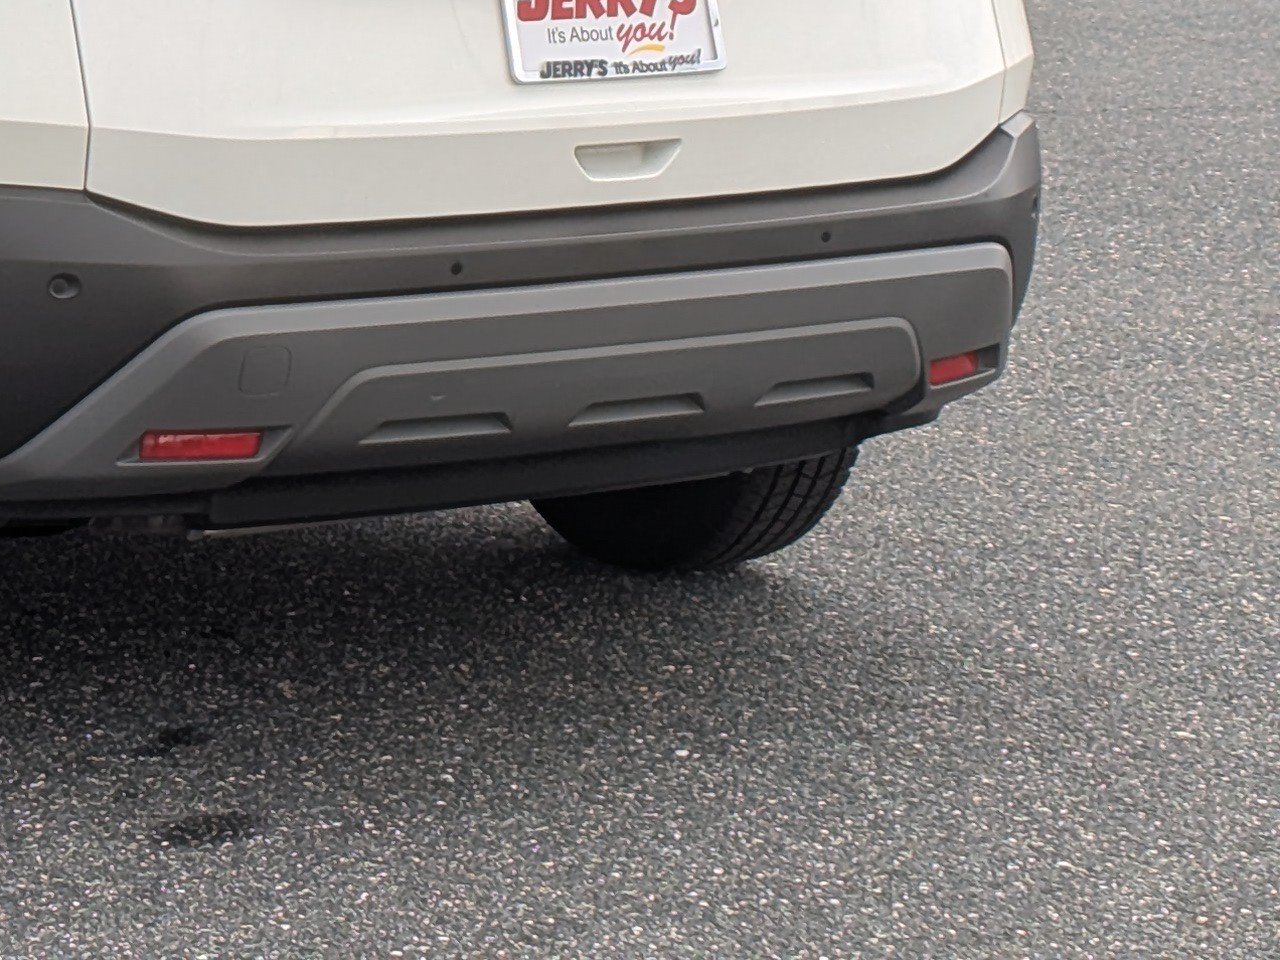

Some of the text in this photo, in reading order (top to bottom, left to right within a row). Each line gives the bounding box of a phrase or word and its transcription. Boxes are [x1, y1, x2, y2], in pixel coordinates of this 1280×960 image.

[547, 10, 675, 52] It's About you!
[540, 59, 609, 79] JERRY'S
[632, 60, 667, 74] About
